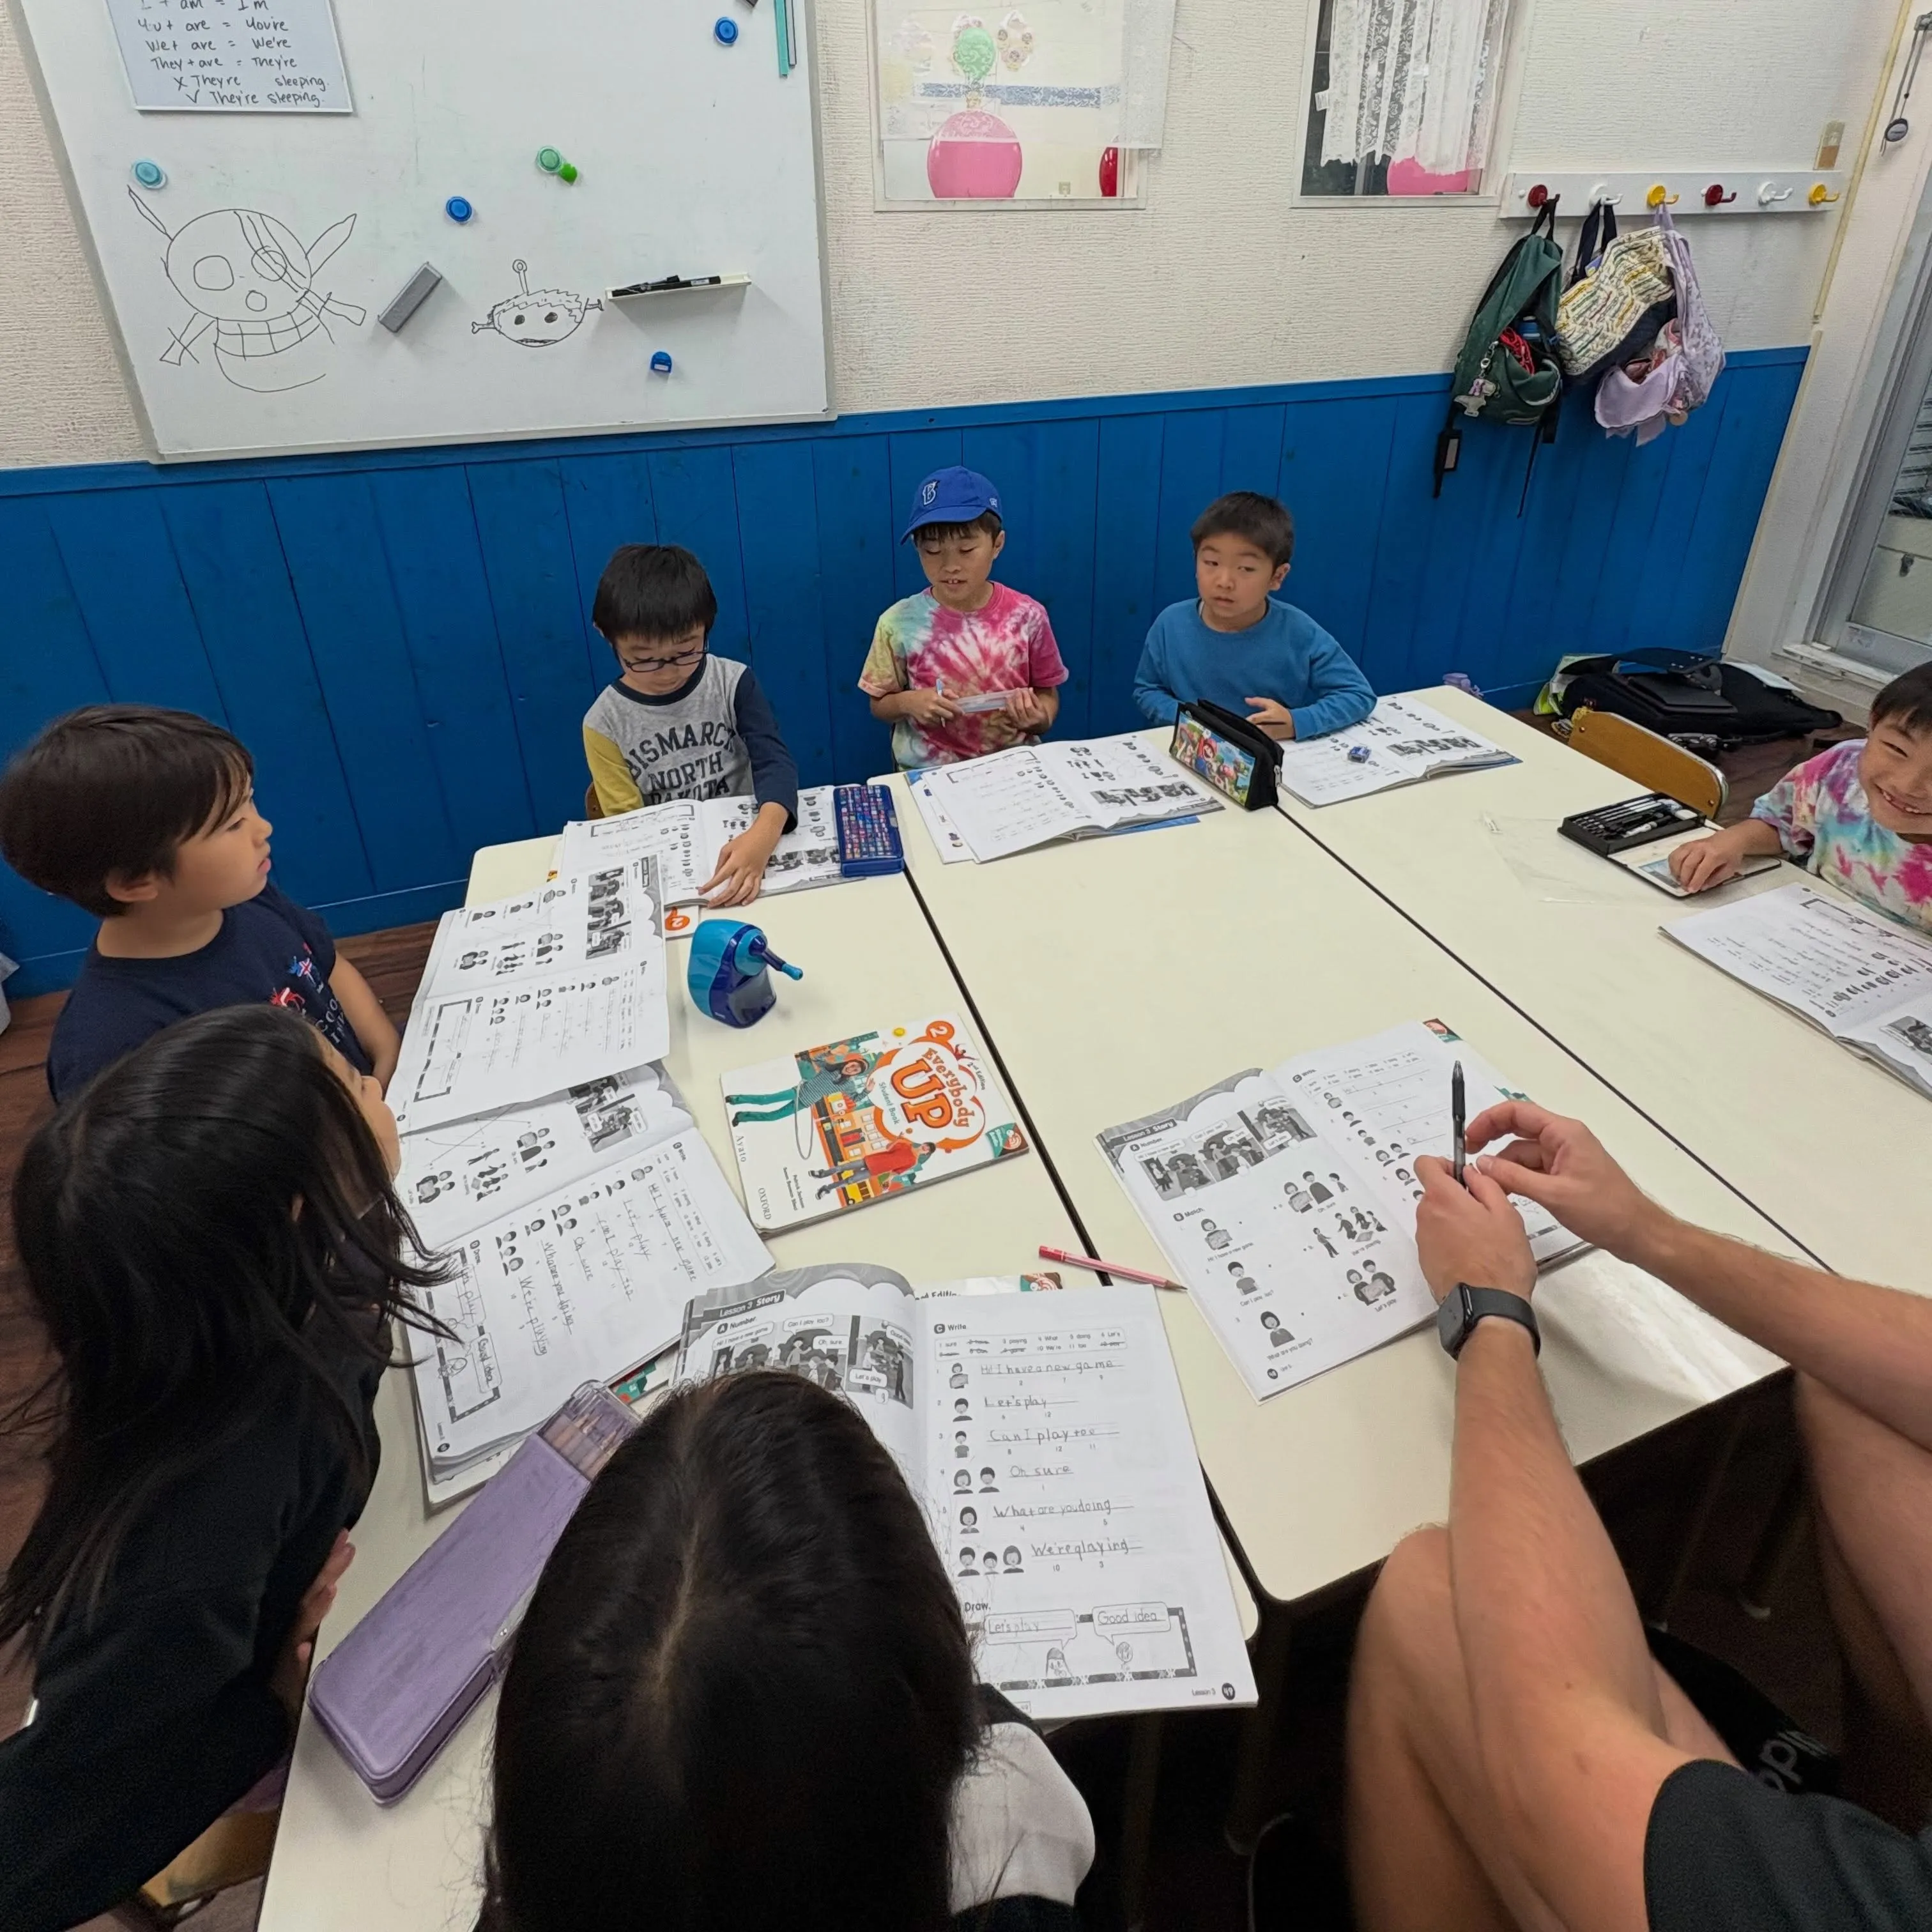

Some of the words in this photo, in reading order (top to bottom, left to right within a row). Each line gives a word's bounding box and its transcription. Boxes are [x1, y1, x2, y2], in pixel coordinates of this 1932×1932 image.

[180, 0, 204, 9] am
[186, 20, 210, 31] are
[191, 40, 217, 50] are
[252, 36, 291, 49] We're
[151, 56, 182, 72] They
[199, 57, 223, 68] are
[252, 54, 297, 70] They're
[209, 89, 259, 106] They're
[648, 751, 724, 792] NORTH
[930, 1025, 948, 1038] 2
[922, 1047, 976, 1128] Everybody
[974, 1070, 986, 1091] Edition
[891, 1058, 953, 1129] UP
[878, 1082, 893, 1107] Student
[889, 1105, 900, 1125] Book
[1152, 1121, 1174, 1133] Story
[736, 1135, 746, 1163] Ayato
[758, 1187, 772, 1220] OXFORD
[719, 1305, 746, 1317] Lesson
[746, 1301, 753, 1310] 3
[756, 1294, 781, 1307] Story
[1006, 1364, 1032, 1374] have
[1076, 1360, 1114, 1374] game
[985, 1395, 1022, 1407] Let's
[1024, 1395, 1047, 1410] play
[990, 1430, 1022, 1442] Can
[1037, 1428, 1069, 1445] play
[1073, 1428, 1095, 1437] too
[1009, 1465, 1026, 1477] Oh
[1035, 1465, 1070, 1476] sure
[993, 1504, 1034, 1518] What
[1038, 1505, 1055, 1515] are
[1053, 1564, 1061, 1572] 10
[964, 1601, 992, 1612] Draw.
[1097, 1610, 1128, 1625] Good
[1134, 1610, 1158, 1622] idea
[989, 1620, 1011, 1634] Let's
